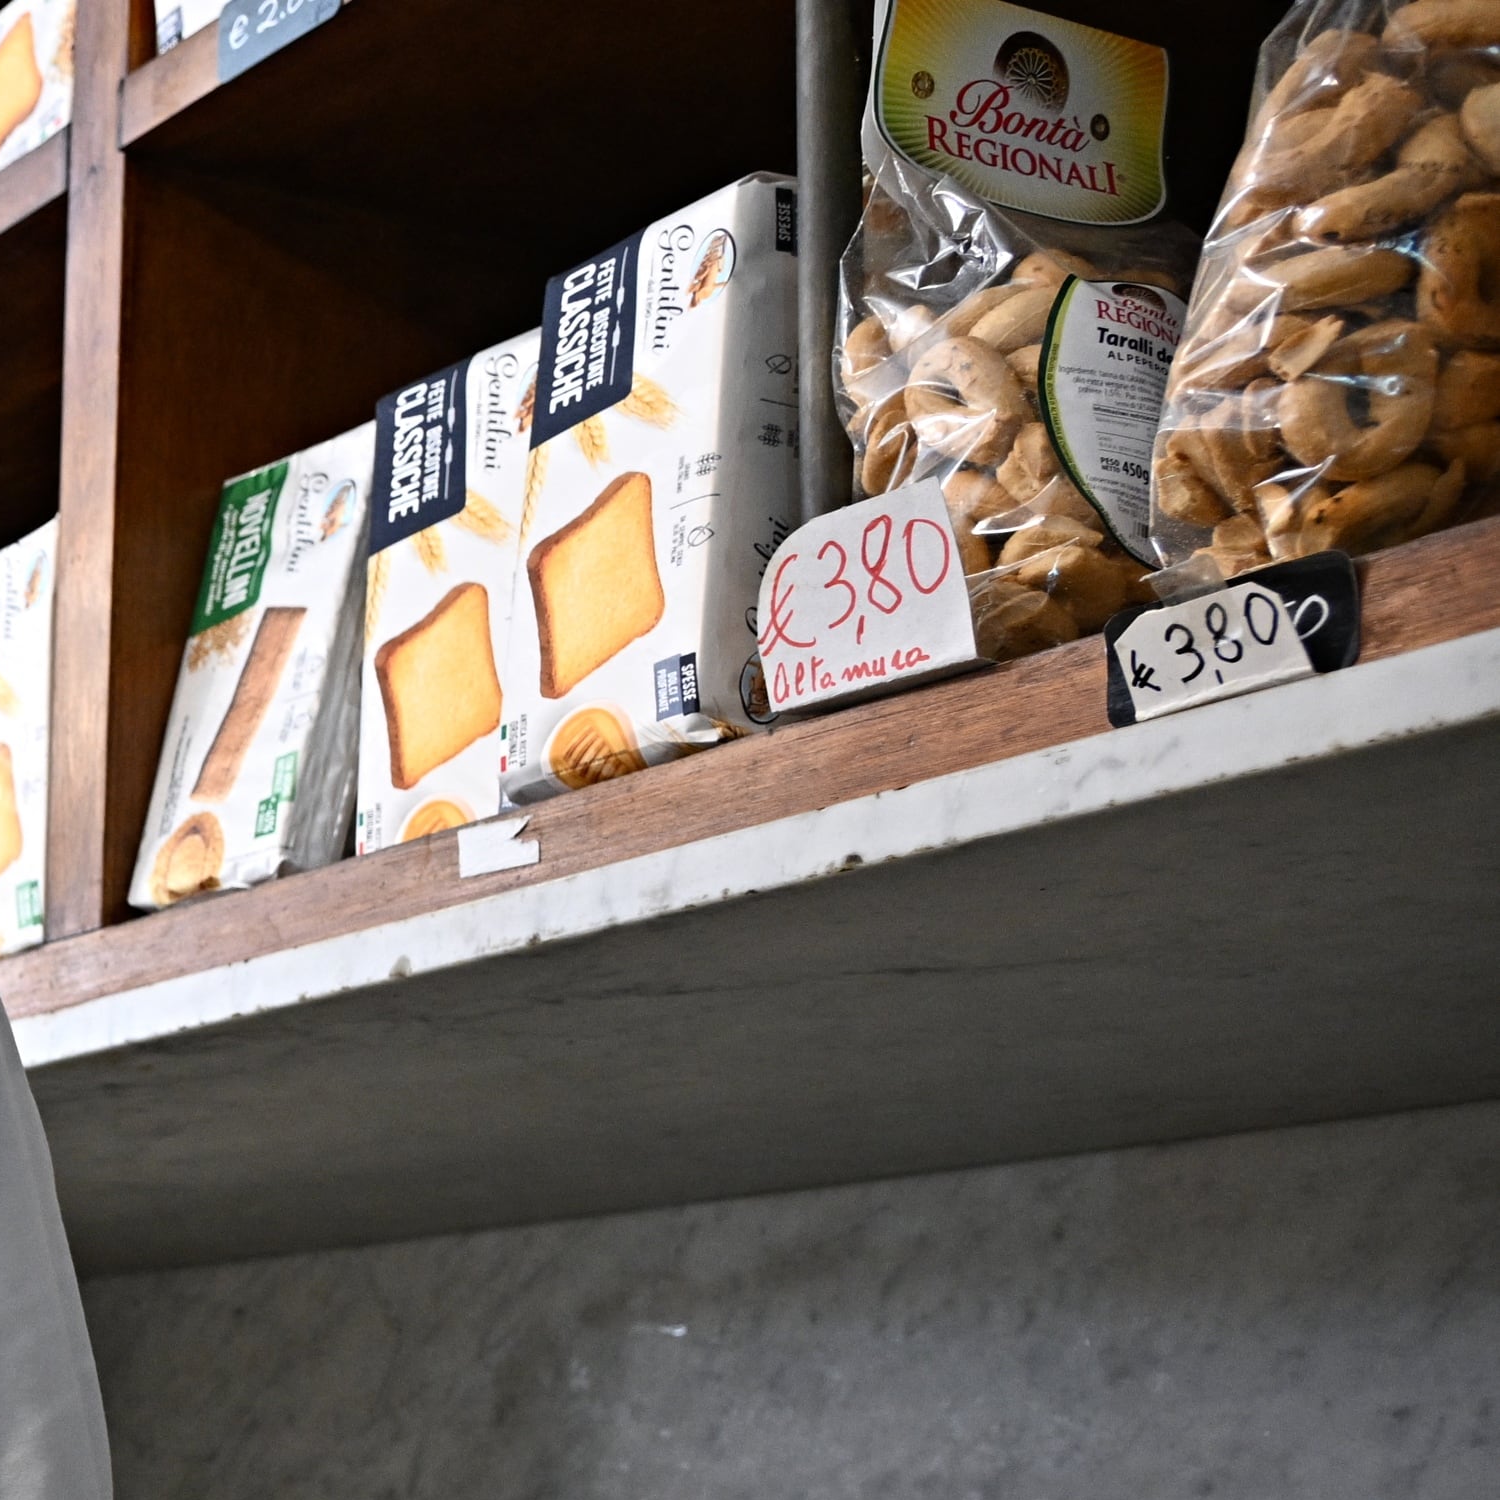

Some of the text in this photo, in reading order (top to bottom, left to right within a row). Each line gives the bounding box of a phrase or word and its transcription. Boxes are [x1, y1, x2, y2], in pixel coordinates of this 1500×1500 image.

[229, 15, 249, 49] €
[949, 79, 1092, 152] Bontà
[924, 114, 1120, 196] REGIONALI
[778, 201, 792, 242] SPESSE
[586, 257, 617, 391] FETTE BISCOTTATE
[652, 224, 695, 355] Gentilini
[549, 263, 597, 415] CLASSICHE
[1097, 327, 1153, 357] Taralli
[421, 378, 446, 503] FETTE BISCOTTATE
[484, 353, 519, 472] Gentilini
[388, 382, 428, 524] CLASSICHE
[1100, 456, 1121, 467] PESO
[1122, 461, 1150, 485] 450g
[758, 554, 817, 657] €
[817, 514, 950, 645] 3,80
[1131, 592, 1279, 692] € 3,80
[656, 669, 669, 713] PROFUMATE
[667, 671, 679, 695] DOLCI
[681, 662, 696, 701] SPESSE
